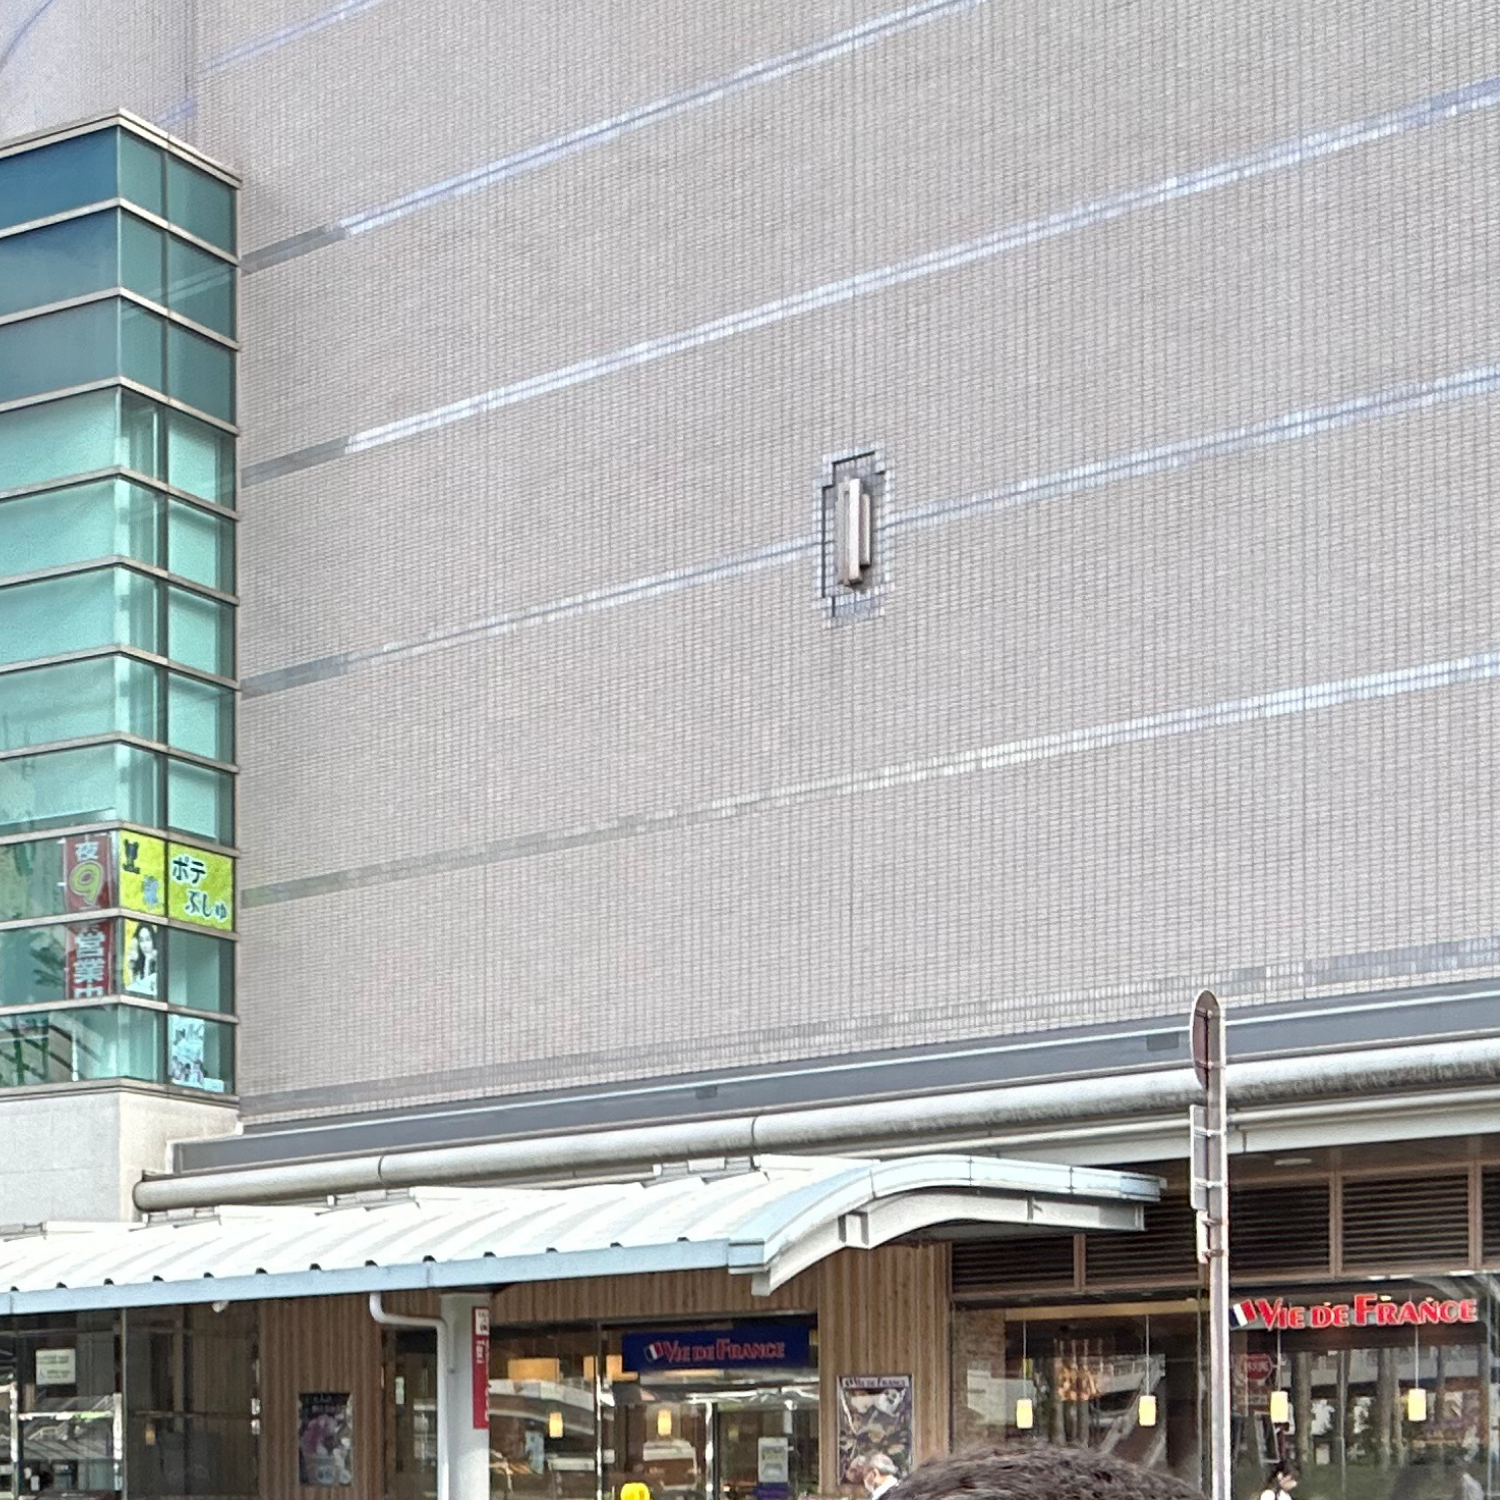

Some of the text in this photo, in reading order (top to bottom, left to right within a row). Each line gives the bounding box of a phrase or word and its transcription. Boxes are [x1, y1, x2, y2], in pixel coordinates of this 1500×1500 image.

[1254, 1292, 1479, 1332] VIE DE FRANCE
